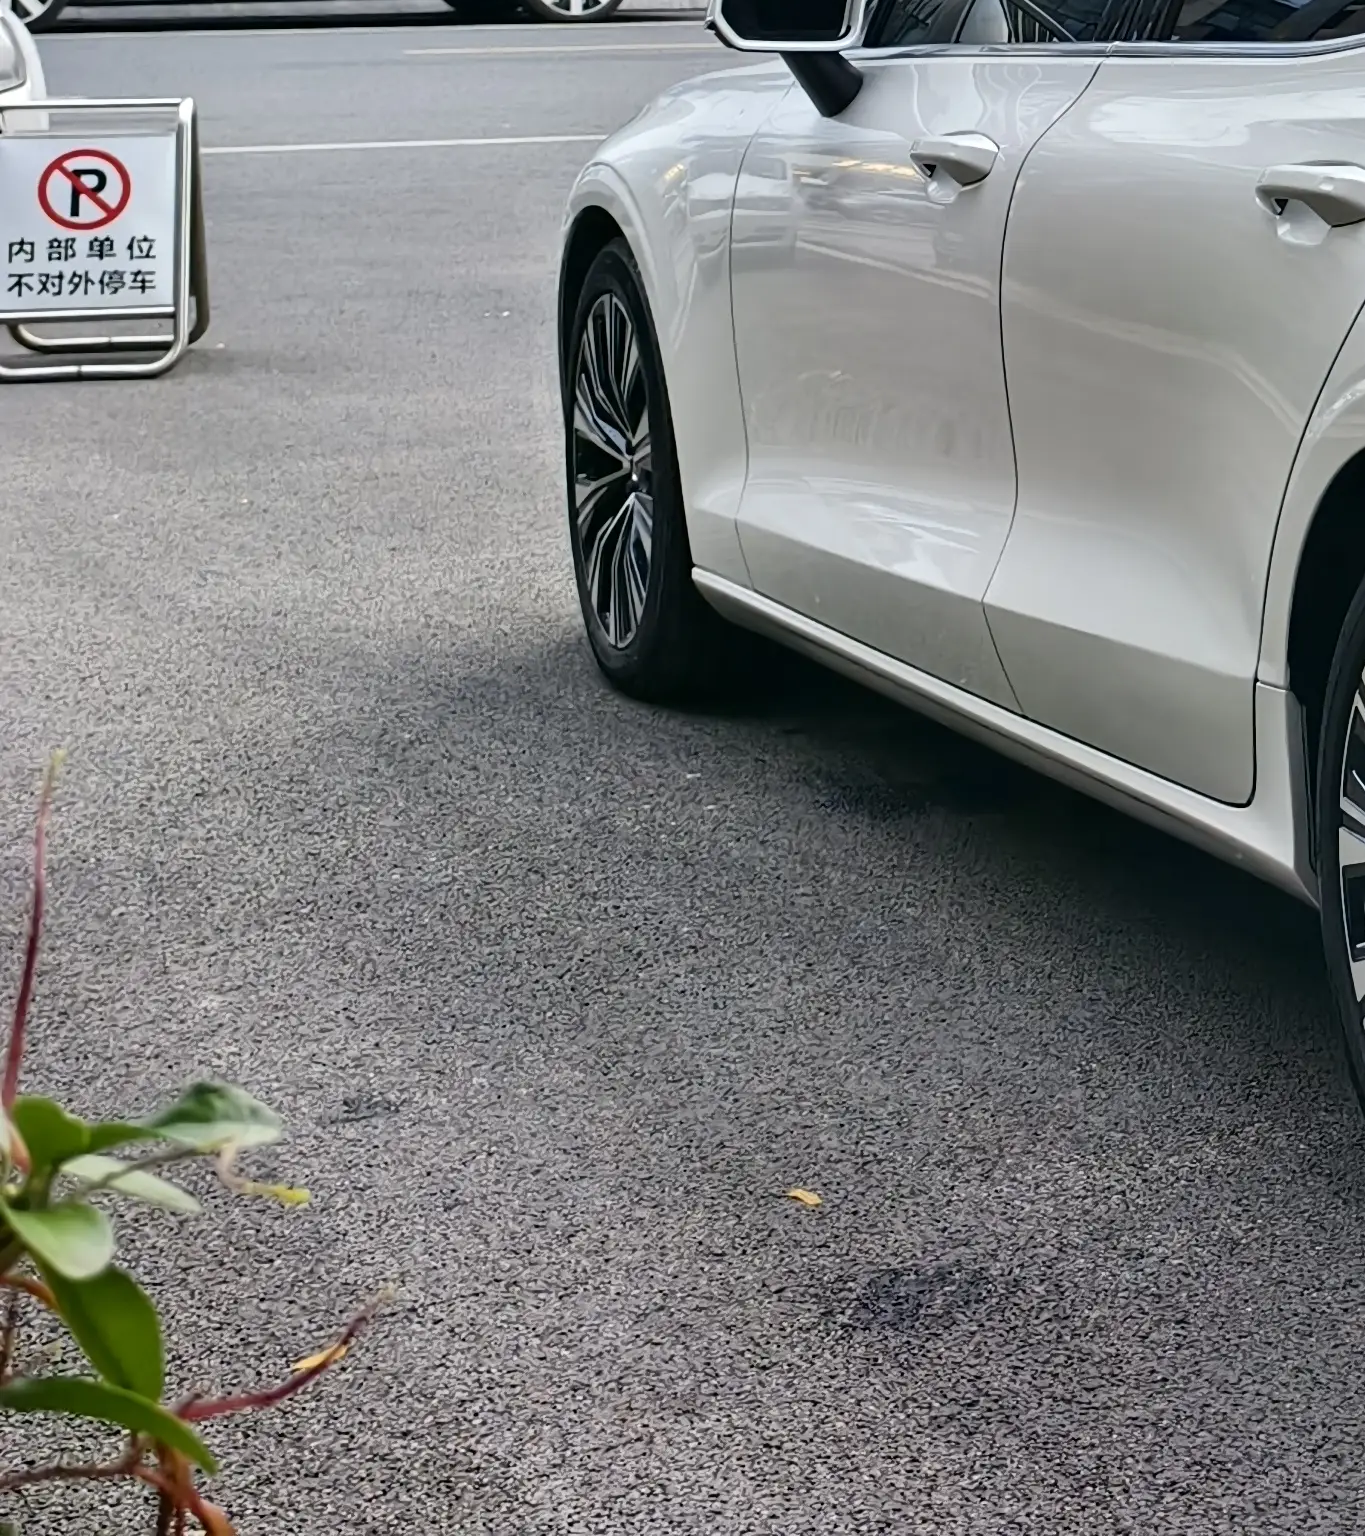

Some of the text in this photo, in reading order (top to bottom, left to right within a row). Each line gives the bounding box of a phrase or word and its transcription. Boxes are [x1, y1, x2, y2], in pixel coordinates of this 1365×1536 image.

[8, 236, 157, 263] 内部单位
[7, 269, 157, 298] 不对外停车
